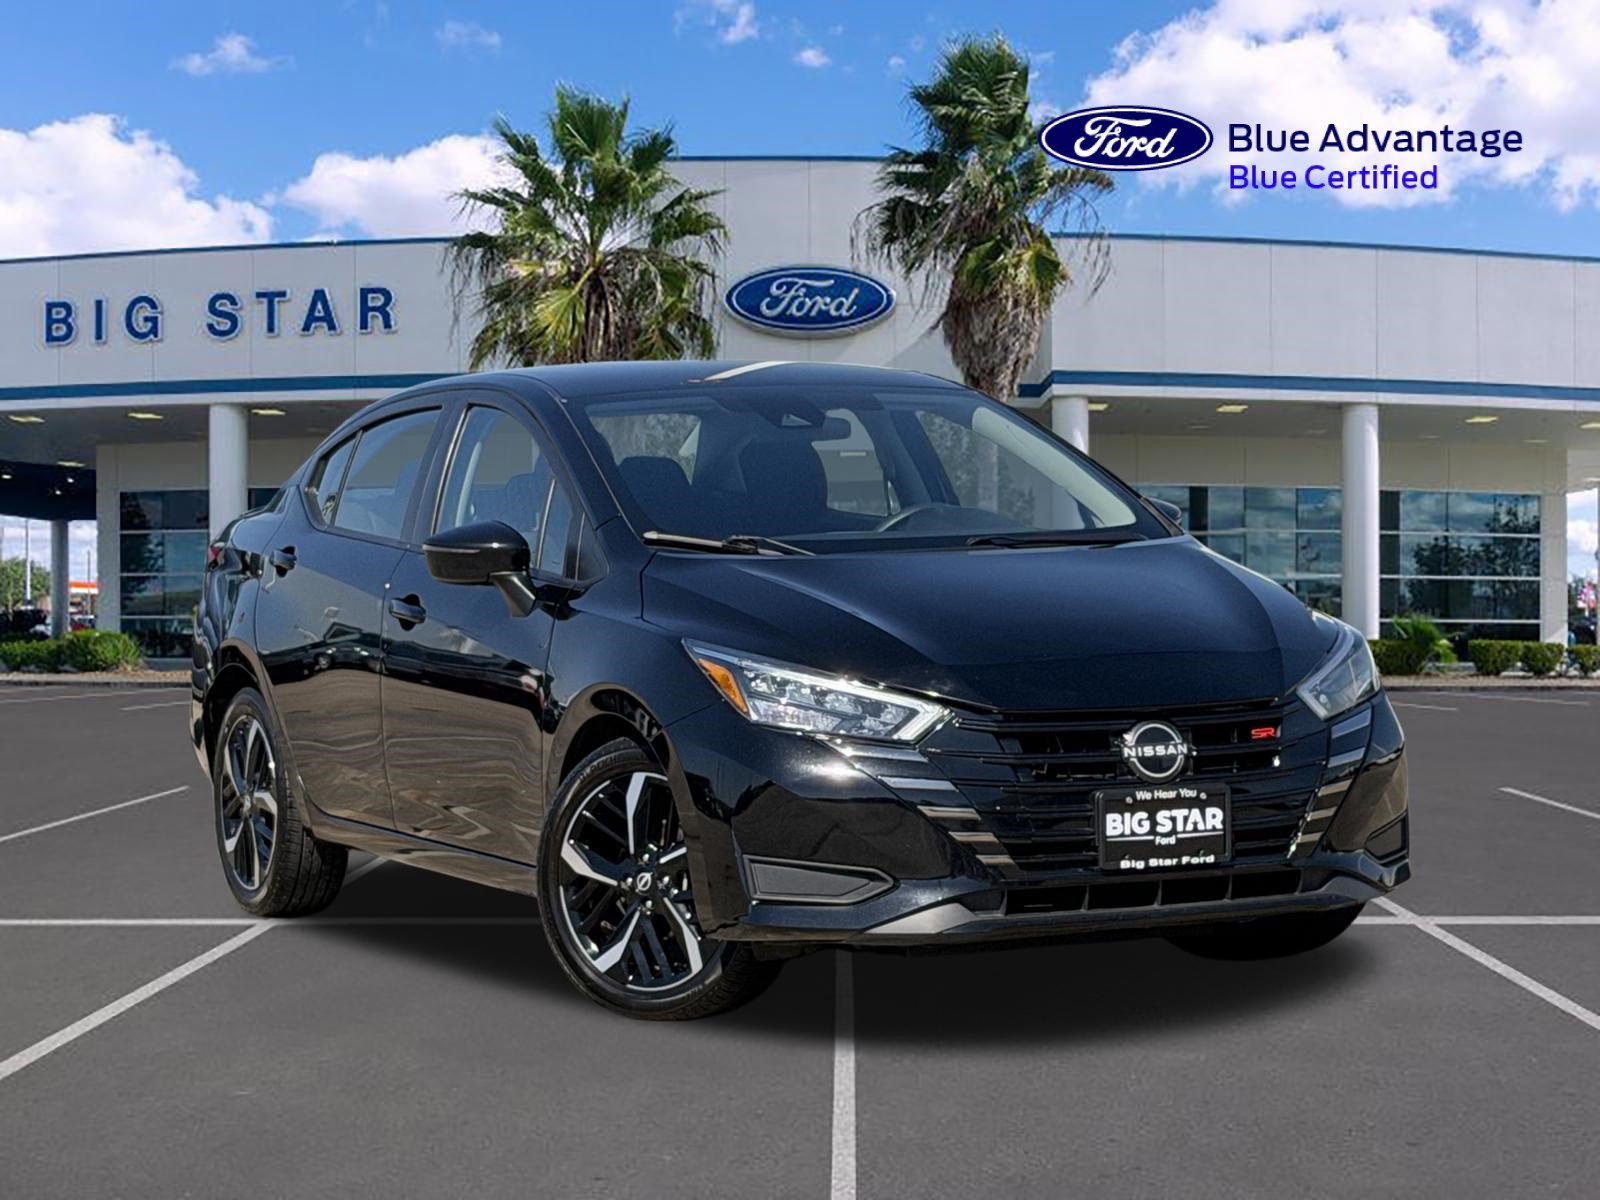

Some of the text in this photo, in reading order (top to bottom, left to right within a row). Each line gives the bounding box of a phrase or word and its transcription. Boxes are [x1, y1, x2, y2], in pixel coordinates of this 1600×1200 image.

[759, 276, 859, 318] Ford
[44, 286, 397, 344] BIG STAR
[1250, 727, 1276, 740] SR
[1122, 743, 1188, 759] NISSAN
[1135, 788, 1198, 801] We Hear You
[1105, 806, 1224, 837] BIG STAR
[1155, 834, 1177, 846] Ford
[1119, 854, 1215, 870] Big Star Ford
